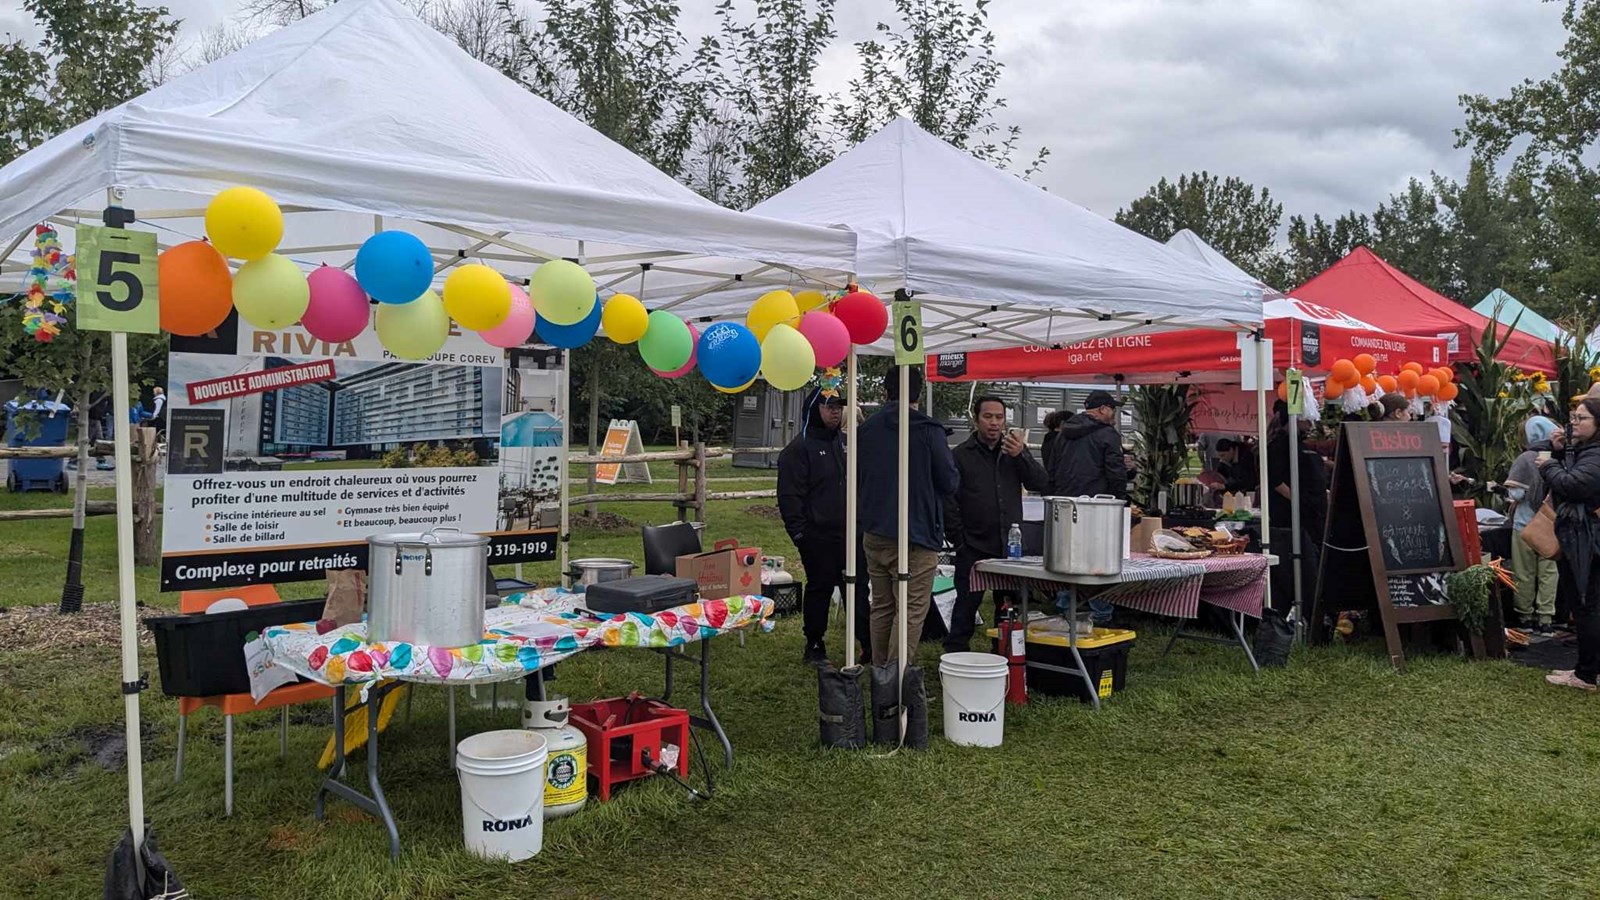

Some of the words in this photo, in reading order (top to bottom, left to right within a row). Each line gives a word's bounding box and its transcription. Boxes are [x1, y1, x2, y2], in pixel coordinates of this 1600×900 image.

[96, 249, 144, 312] 5
[901, 315, 918, 352] 6
[1098, 337, 1113, 349] EN
[1116, 335, 1152, 348] LIGNE
[1350, 336, 1384, 349] COMMANDEZ
[1391, 342, 1407, 353] LIGNE
[459, 354, 496, 364] COREV
[940, 353, 964, 361] mieux
[940, 359, 964, 368] manger
[1067, 350, 1103, 365] iga.net
[194, 377, 246, 400] NOUVELLE
[249, 363, 331, 389] ADMINISTRATION
[1290, 379, 1300, 405] 7
[183, 432, 209, 458] R
[1370, 430, 1424, 451] Bistro
[192, 478, 266, 490] Offrez-vous
[270, 480, 285, 488] un
[289, 476, 331, 488] endroit
[333, 474, 392, 486] chaleureux
[395, 473, 409, 484] où
[412, 475, 436, 484] vous
[439, 474, 477, 485] pourrez
[191, 493, 241, 509] profiter
[243, 493, 278, 504] d'une
[281, 489, 337, 503] multitude
[340, 489, 354, 500] de
[356, 487, 399, 499] services
[401, 487, 413, 498] et
[415, 486, 466, 498] d'activités
[213, 511, 249, 521] Piscine
[251, 509, 297, 519] intérieure
[313, 507, 327, 517] sel
[344, 506, 383, 517] Gymnase
[385, 504, 400, 513] très
[402, 503, 420, 512] bien
[422, 502, 450, 513] équipé
[212, 522, 238, 532] Salle
[240, 521, 253, 531] de
[255, 520, 280, 530] loisir
[343, 519, 352, 528] Et
[354, 517, 397, 527] beaucoup,
[398, 514, 438, 525] beaucoup
[440, 513, 457, 523] plus
[212, 533, 238, 544] Salle
[240, 532, 253, 542] de
[254, 531, 286, 542] billard
[495, 541, 548, 557] 319-1919
[175, 560, 255, 582] Complexe
[259, 558, 295, 578] pour
[299, 552, 358, 571] retraités
[959, 712, 997, 722] RONA
[482, 815, 533, 832] RONA
